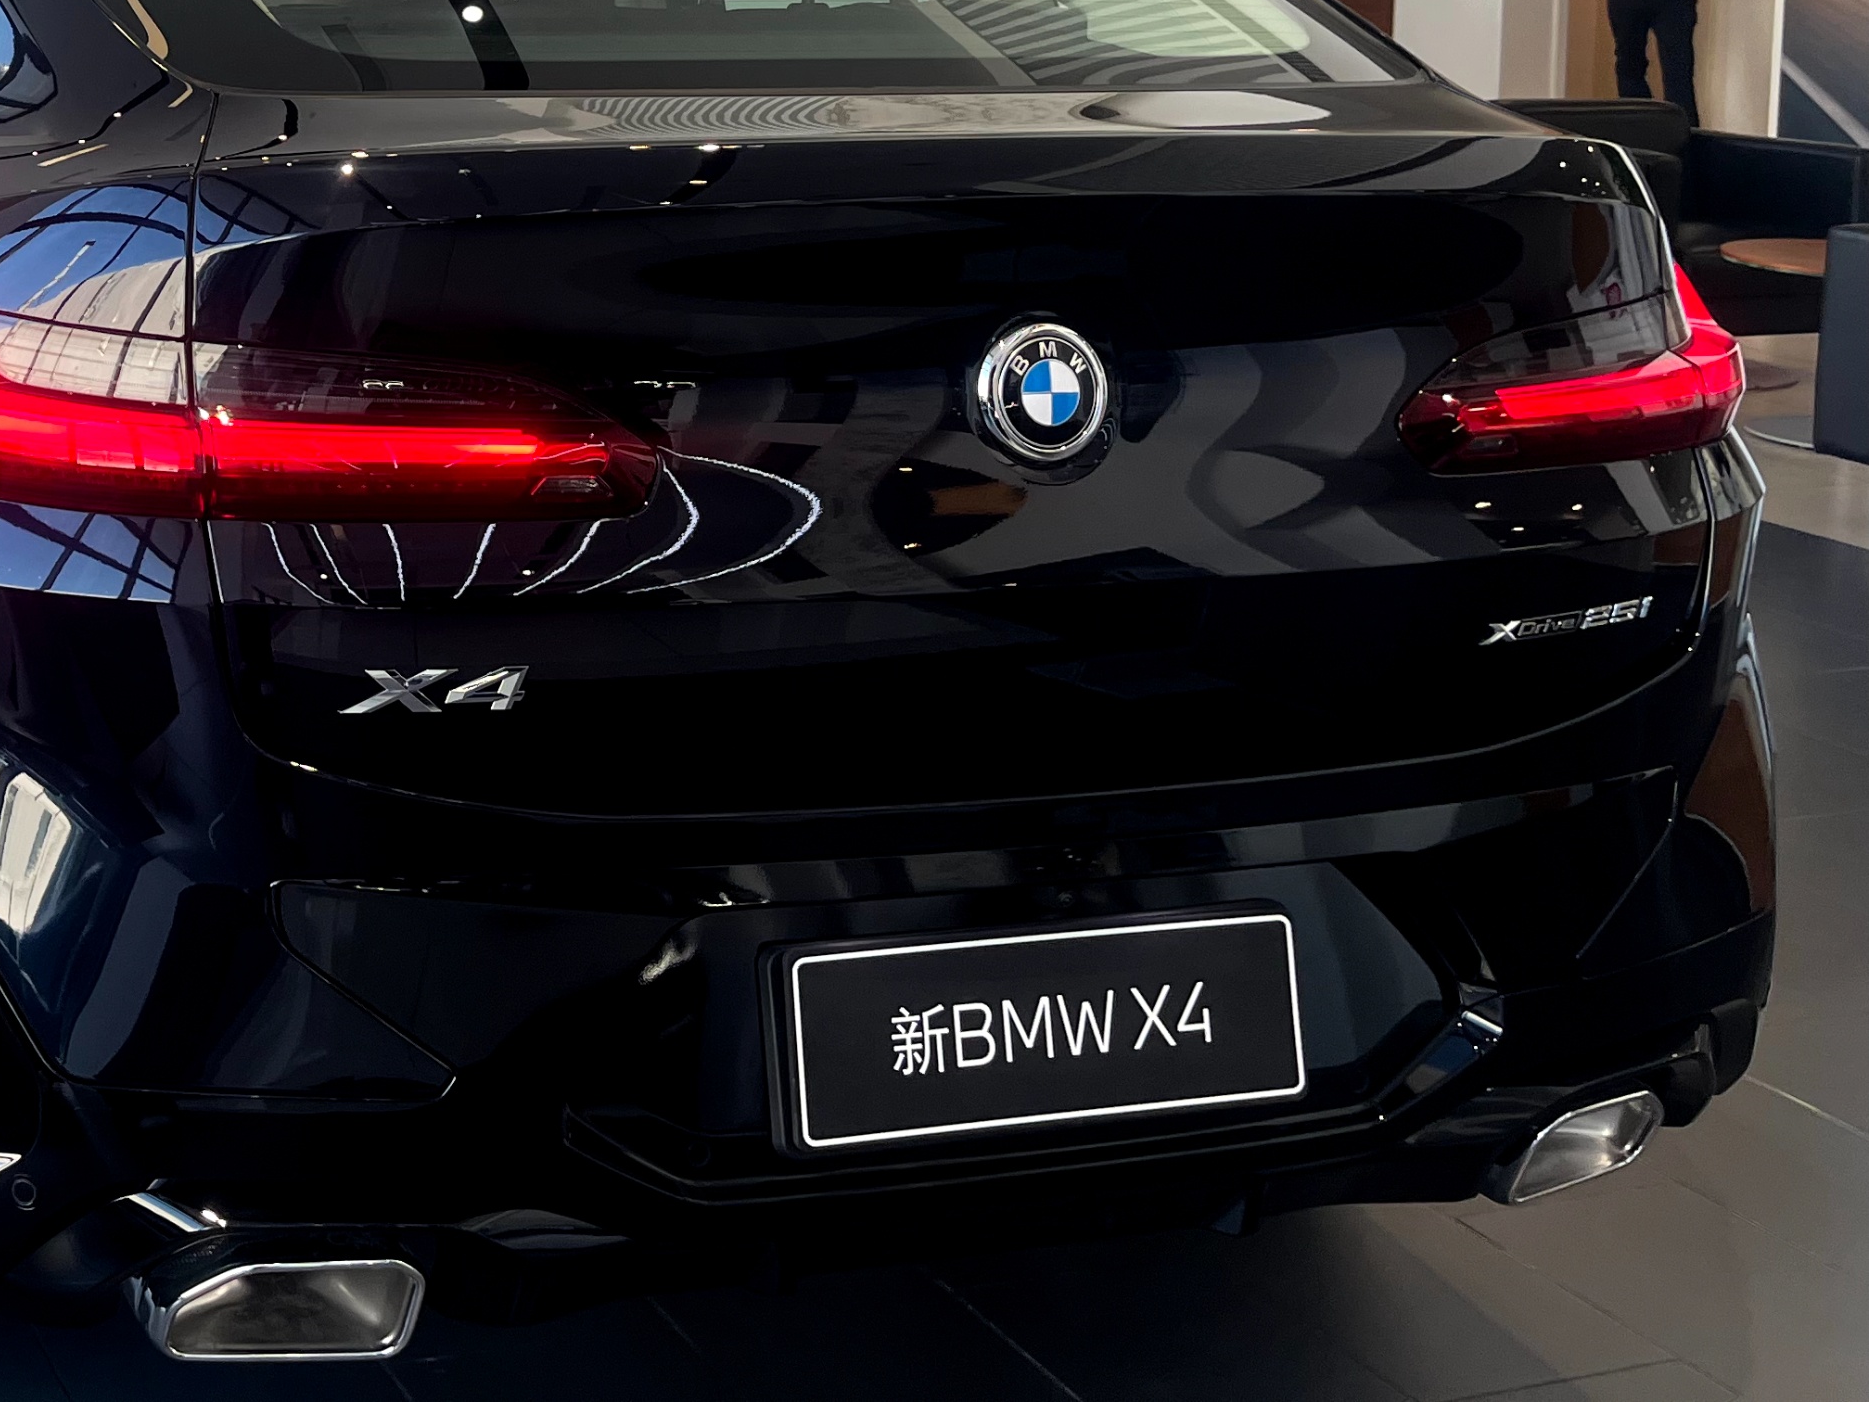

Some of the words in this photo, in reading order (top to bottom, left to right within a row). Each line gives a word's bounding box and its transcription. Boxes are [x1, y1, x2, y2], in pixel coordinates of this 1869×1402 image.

[1009, 341, 1087, 377] BMW
[337, 665, 530, 714] X4
[1129, 981, 1212, 1050] X4
